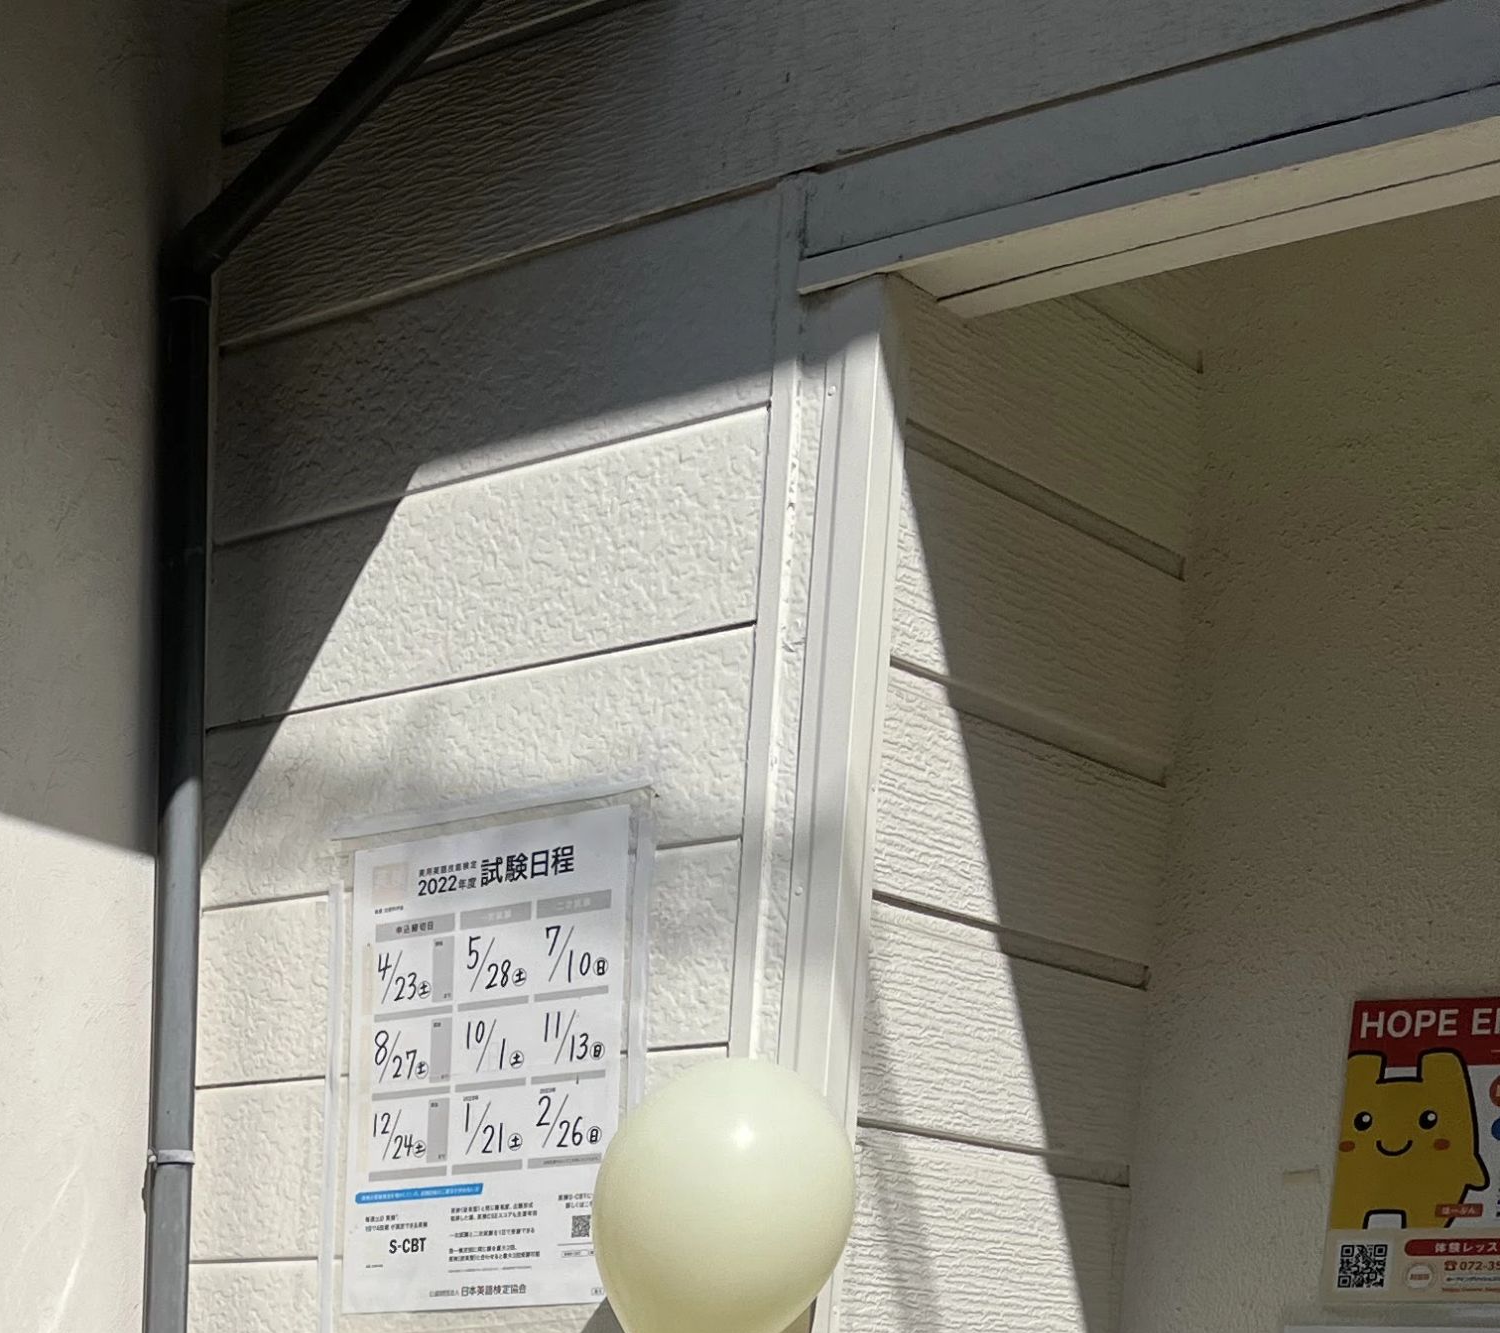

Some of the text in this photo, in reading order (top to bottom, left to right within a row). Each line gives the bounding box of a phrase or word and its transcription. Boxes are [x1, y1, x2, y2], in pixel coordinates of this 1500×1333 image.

[480, 845, 574, 887] 試験日程
[418, 875, 477, 897] 2022年度
[1360, 1008, 1459, 1039] HOPE
[388, 1237, 427, 1254] S-CBT
[461, 1283, 527, 1297] 日本英語検定協会
